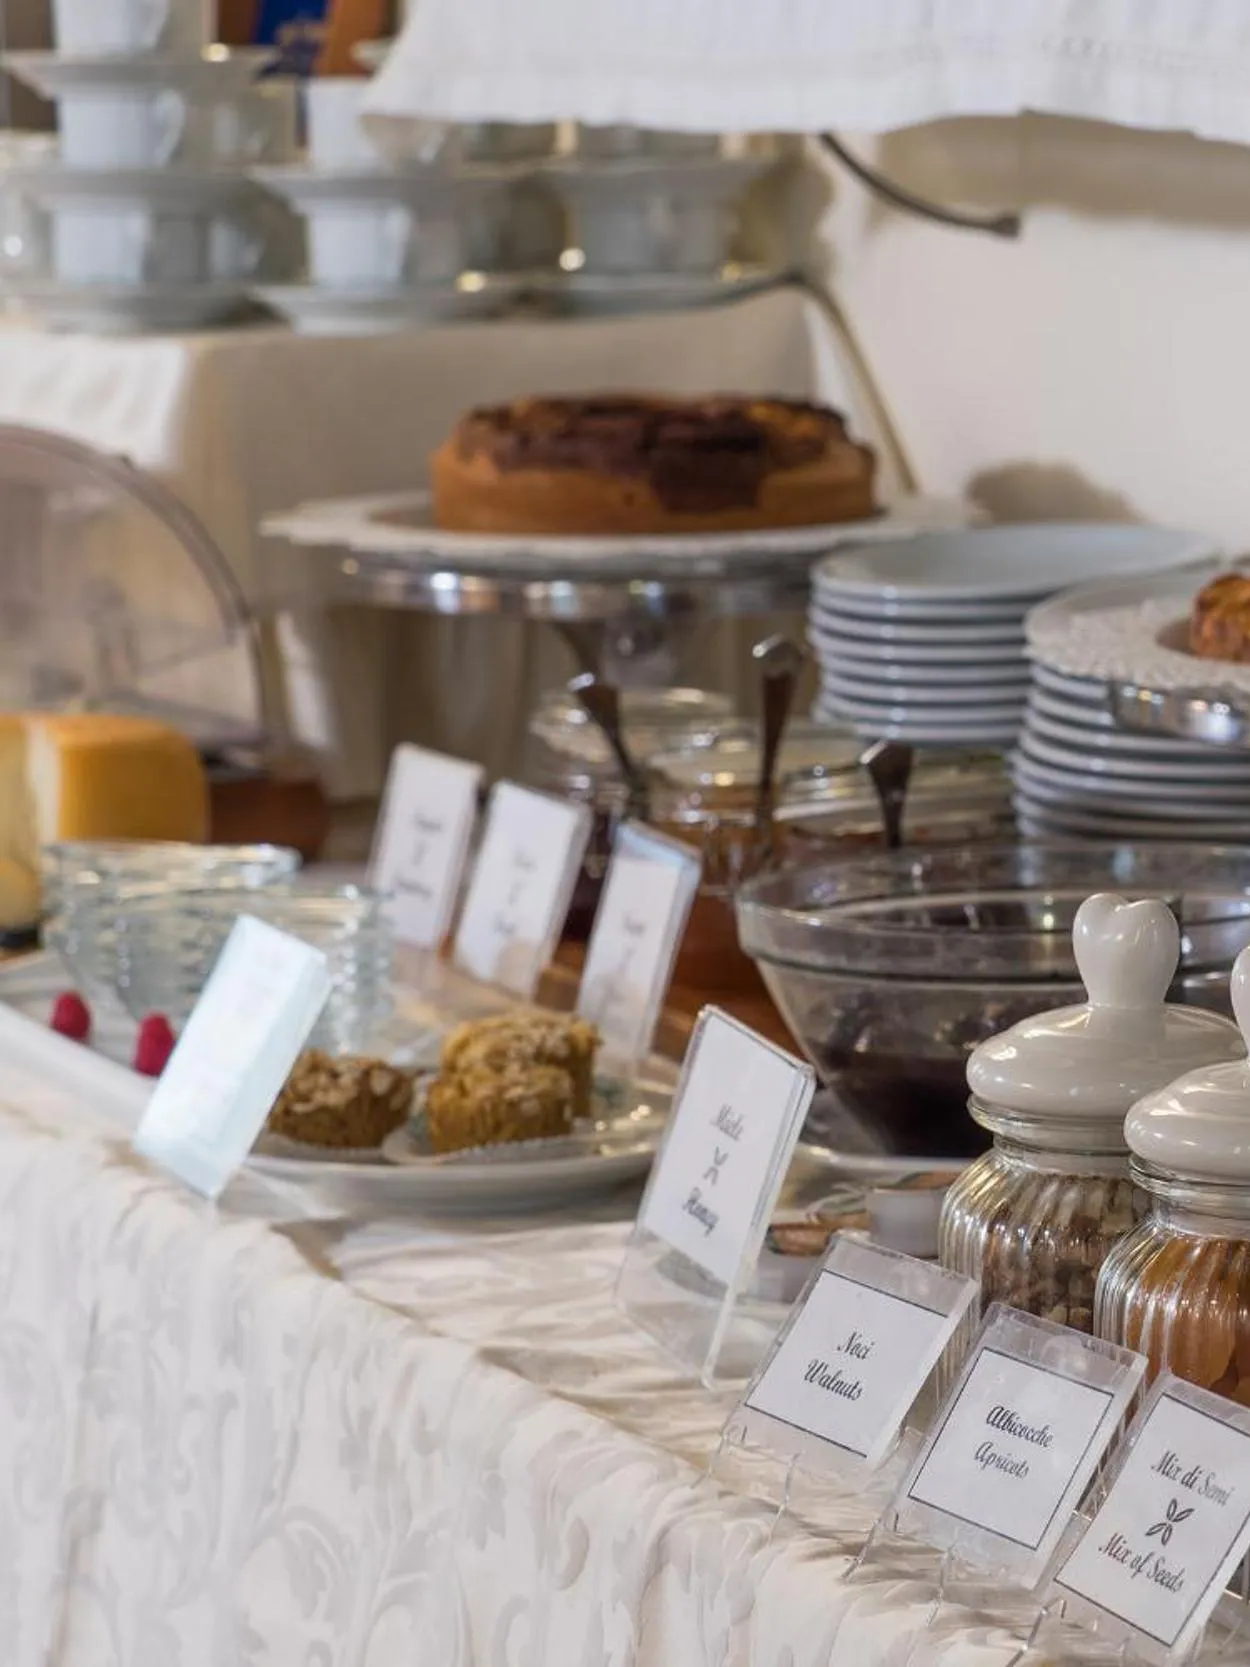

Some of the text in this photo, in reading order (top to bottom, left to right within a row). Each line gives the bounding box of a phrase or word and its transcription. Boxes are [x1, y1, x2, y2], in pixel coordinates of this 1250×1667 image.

[837, 1331, 876, 1360] Noci
[804, 1359, 864, 1401] Walnuts
[985, 1406, 1055, 1448] Albicocche
[974, 1441, 1030, 1480] Apricots
[1150, 1450, 1235, 1506] Mix di Semi
[1098, 1532, 1185, 1593] Mix of Seeds
